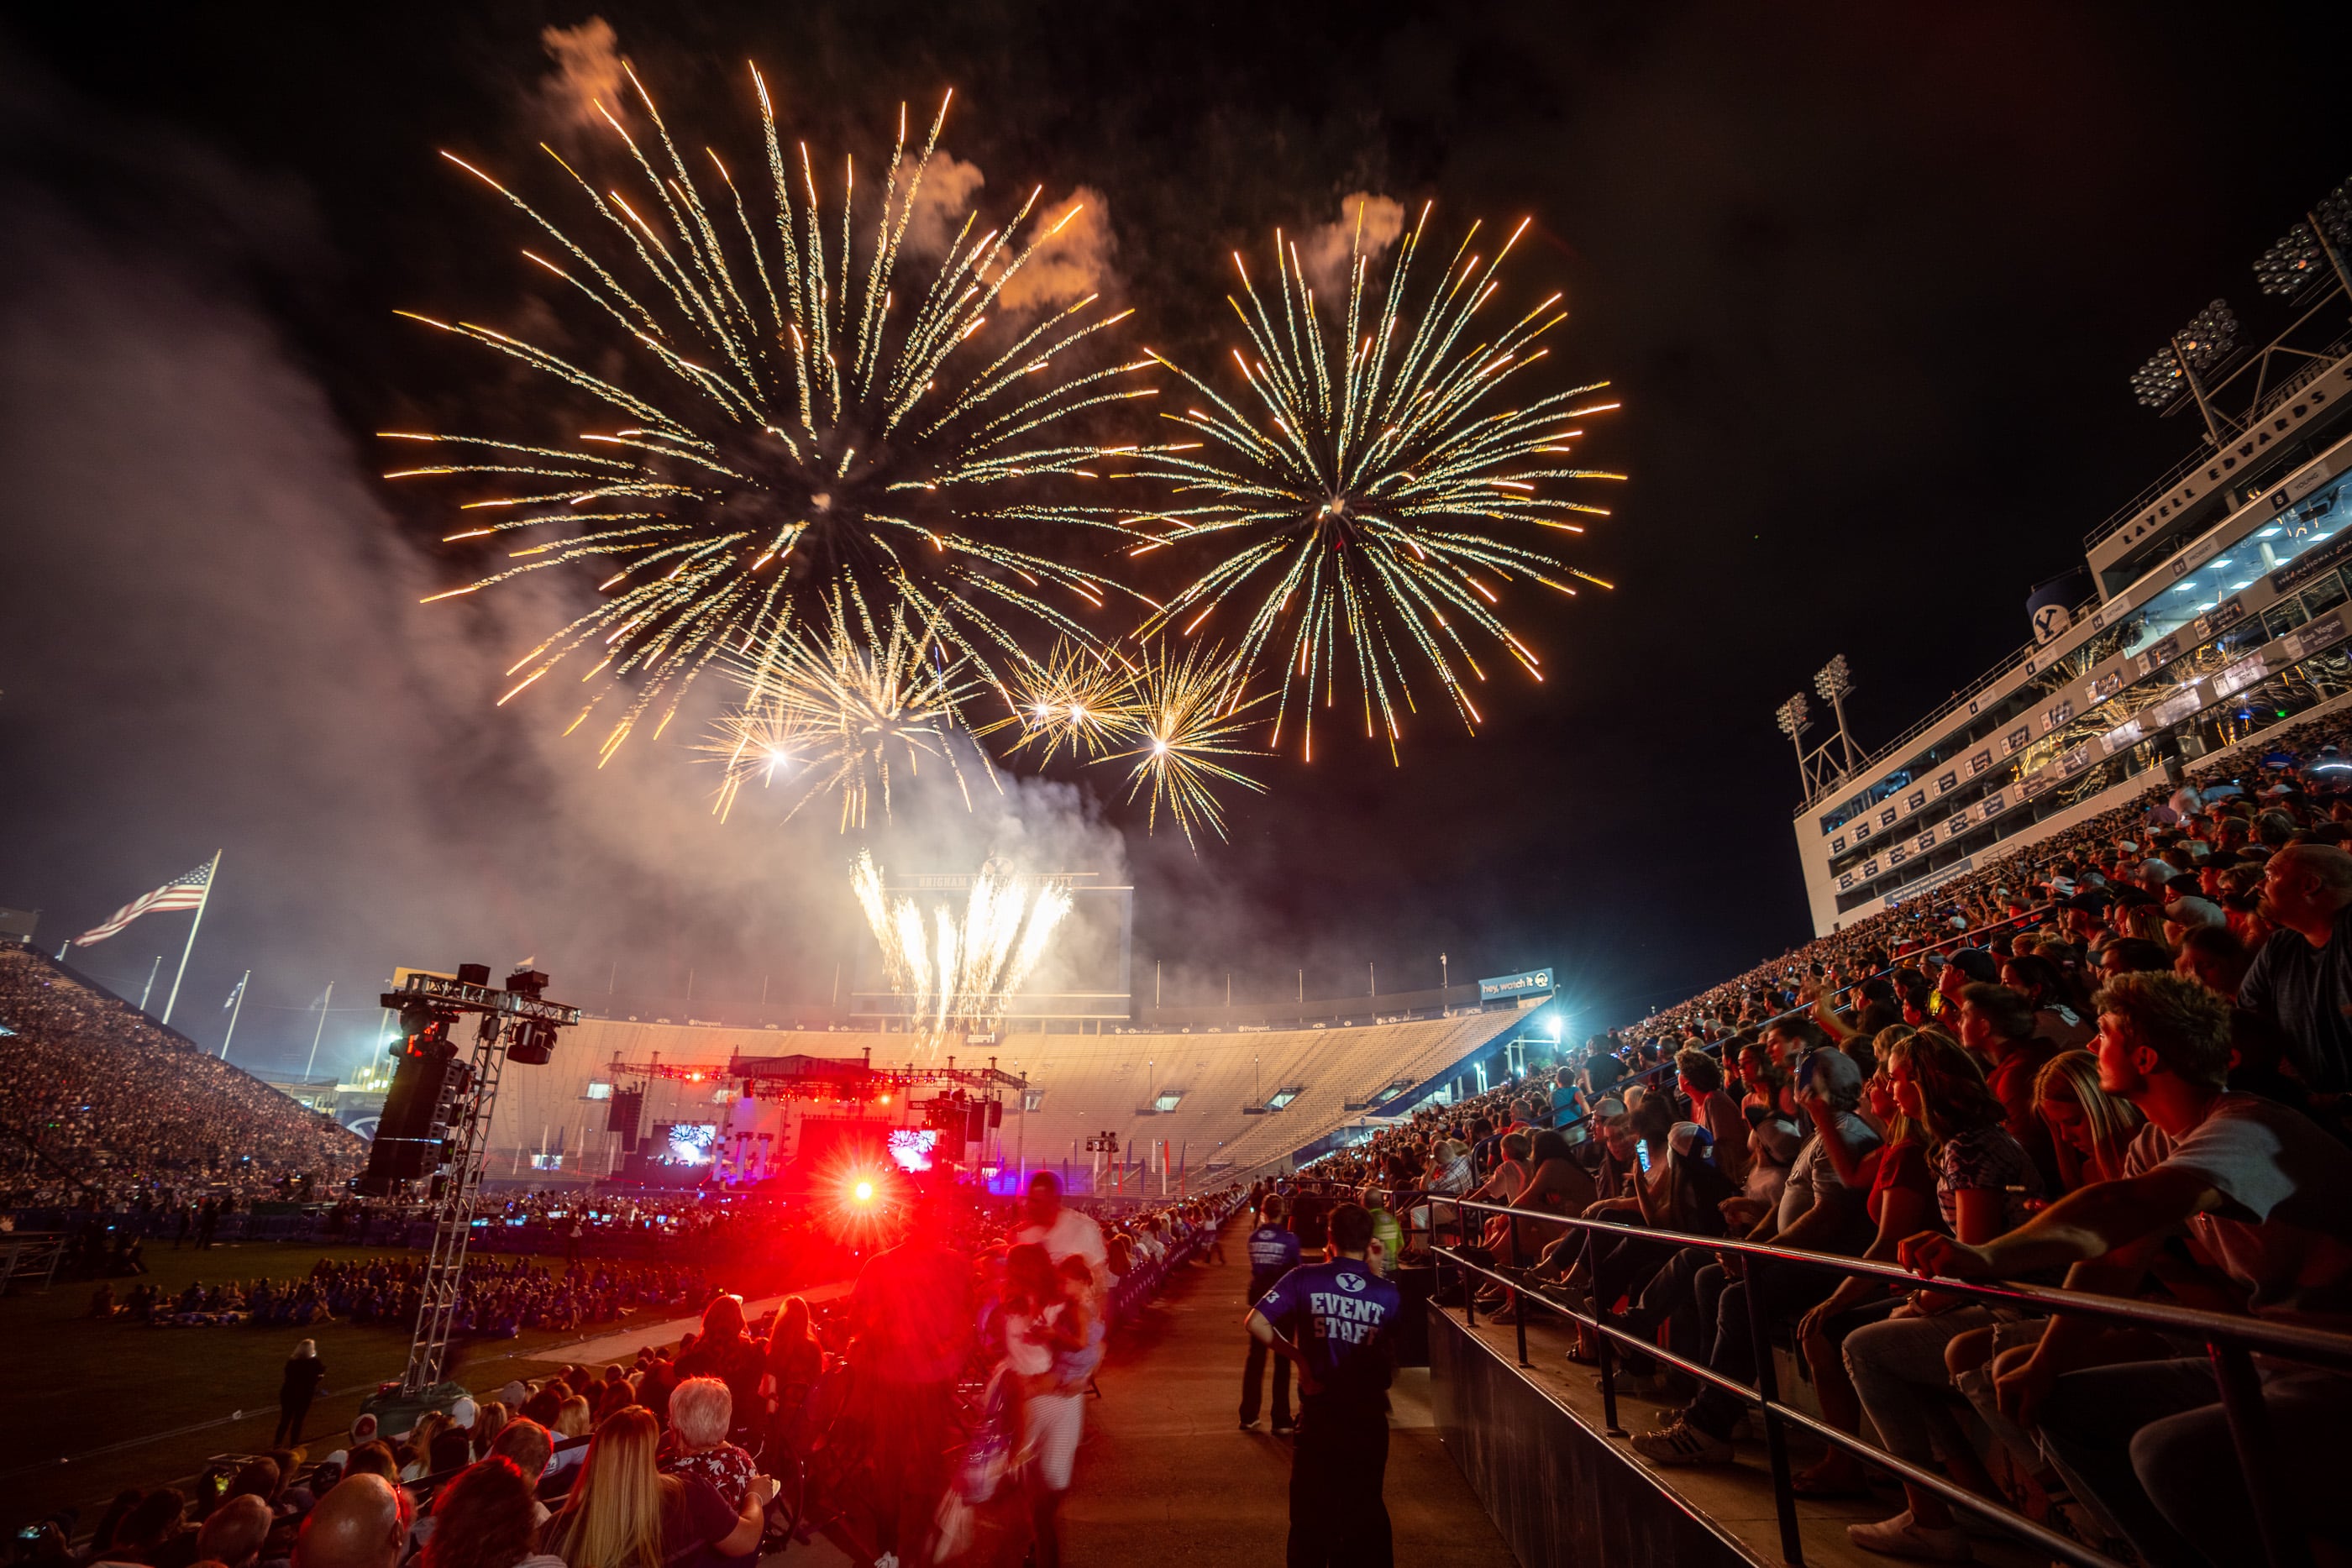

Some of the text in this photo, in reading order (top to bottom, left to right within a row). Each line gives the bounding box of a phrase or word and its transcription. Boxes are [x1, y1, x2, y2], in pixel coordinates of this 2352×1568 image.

[2123, 488, 2196, 544] LAVELL
[2208, 391, 2326, 481] EDWARDS
[2294, 471, 2319, 491] YOUNG
[2034, 608, 2057, 640] Y
[2300, 619, 2341, 644] Las Vegas
[1499, 978, 1526, 991] watch
[1310, 1292, 1385, 1324] EVENT
[1314, 1316, 1379, 1345] STAFF
